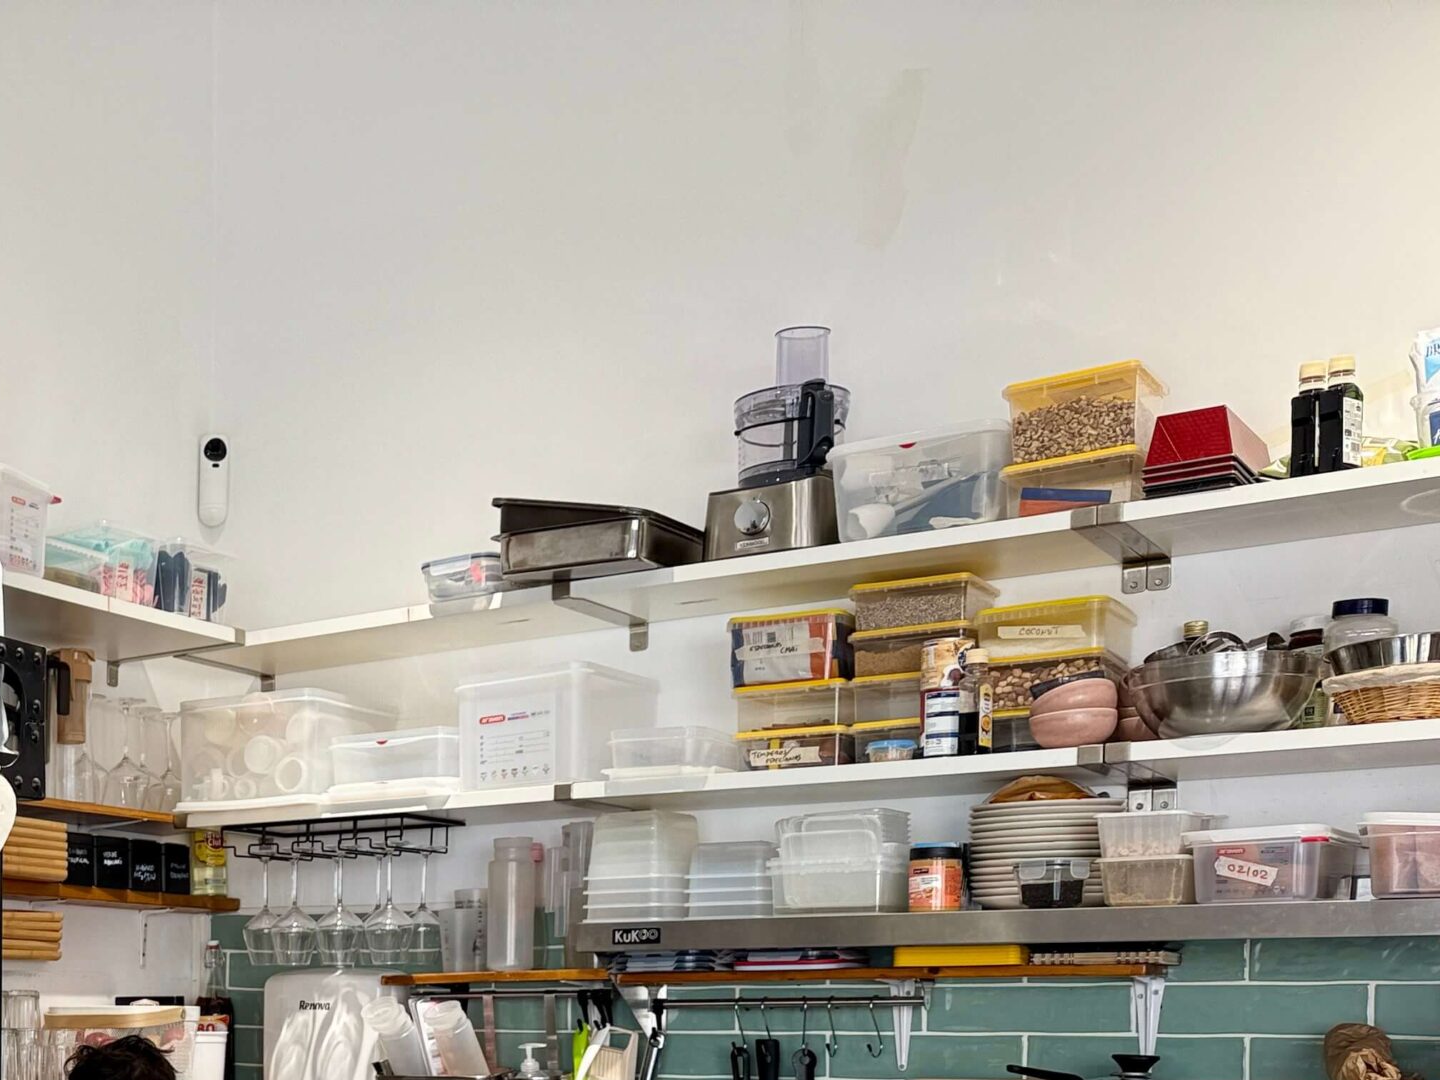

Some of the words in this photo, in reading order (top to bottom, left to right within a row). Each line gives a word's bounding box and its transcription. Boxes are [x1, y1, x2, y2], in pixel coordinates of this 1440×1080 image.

[1019, 626, 1061, 636] COCONUT
[1227, 863, 1268, 880] 02/02
[299, 1000, 331, 1011] Renova
